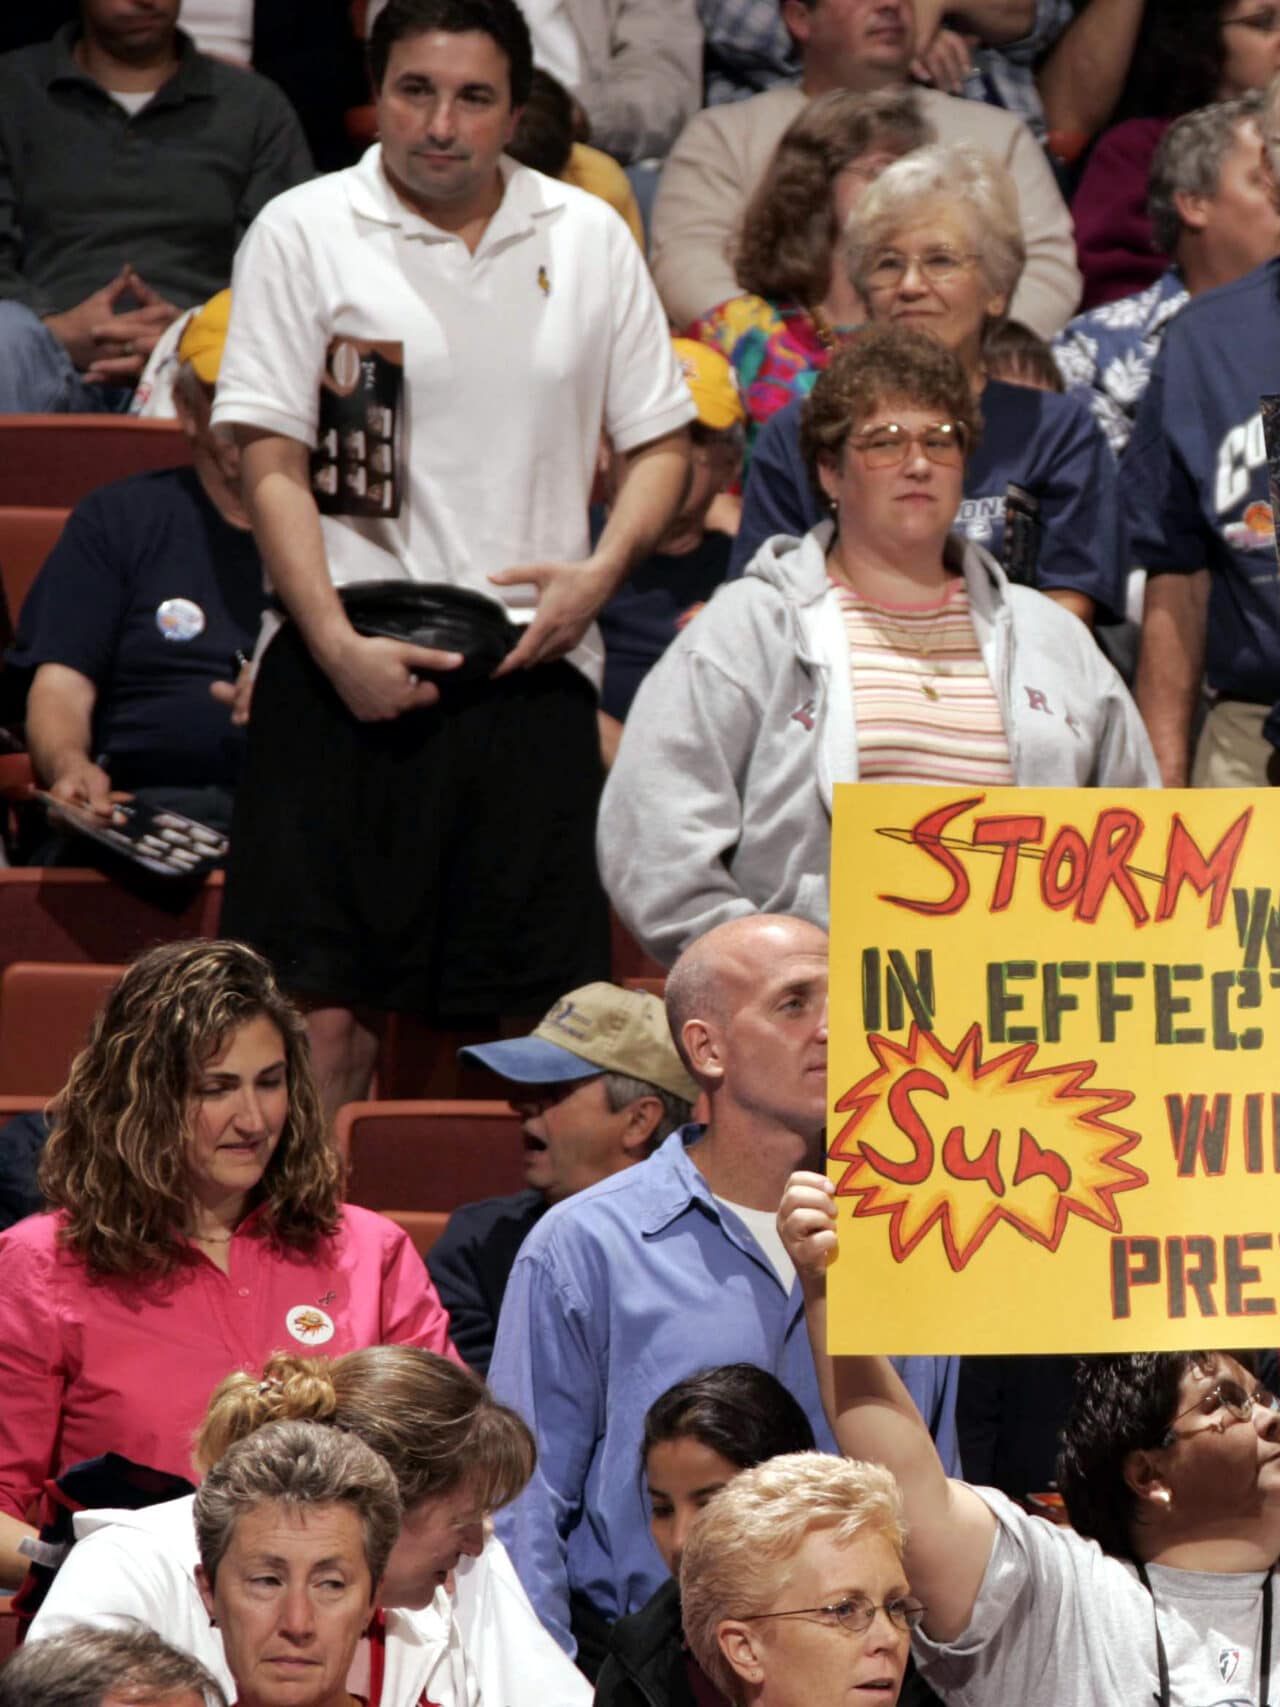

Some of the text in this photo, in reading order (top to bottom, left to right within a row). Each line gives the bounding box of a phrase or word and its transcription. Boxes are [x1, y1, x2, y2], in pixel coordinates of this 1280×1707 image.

[874, 795, 1254, 929] STORM
[862, 947, 935, 1032] IN
[857, 1068, 1072, 1197] Sun
